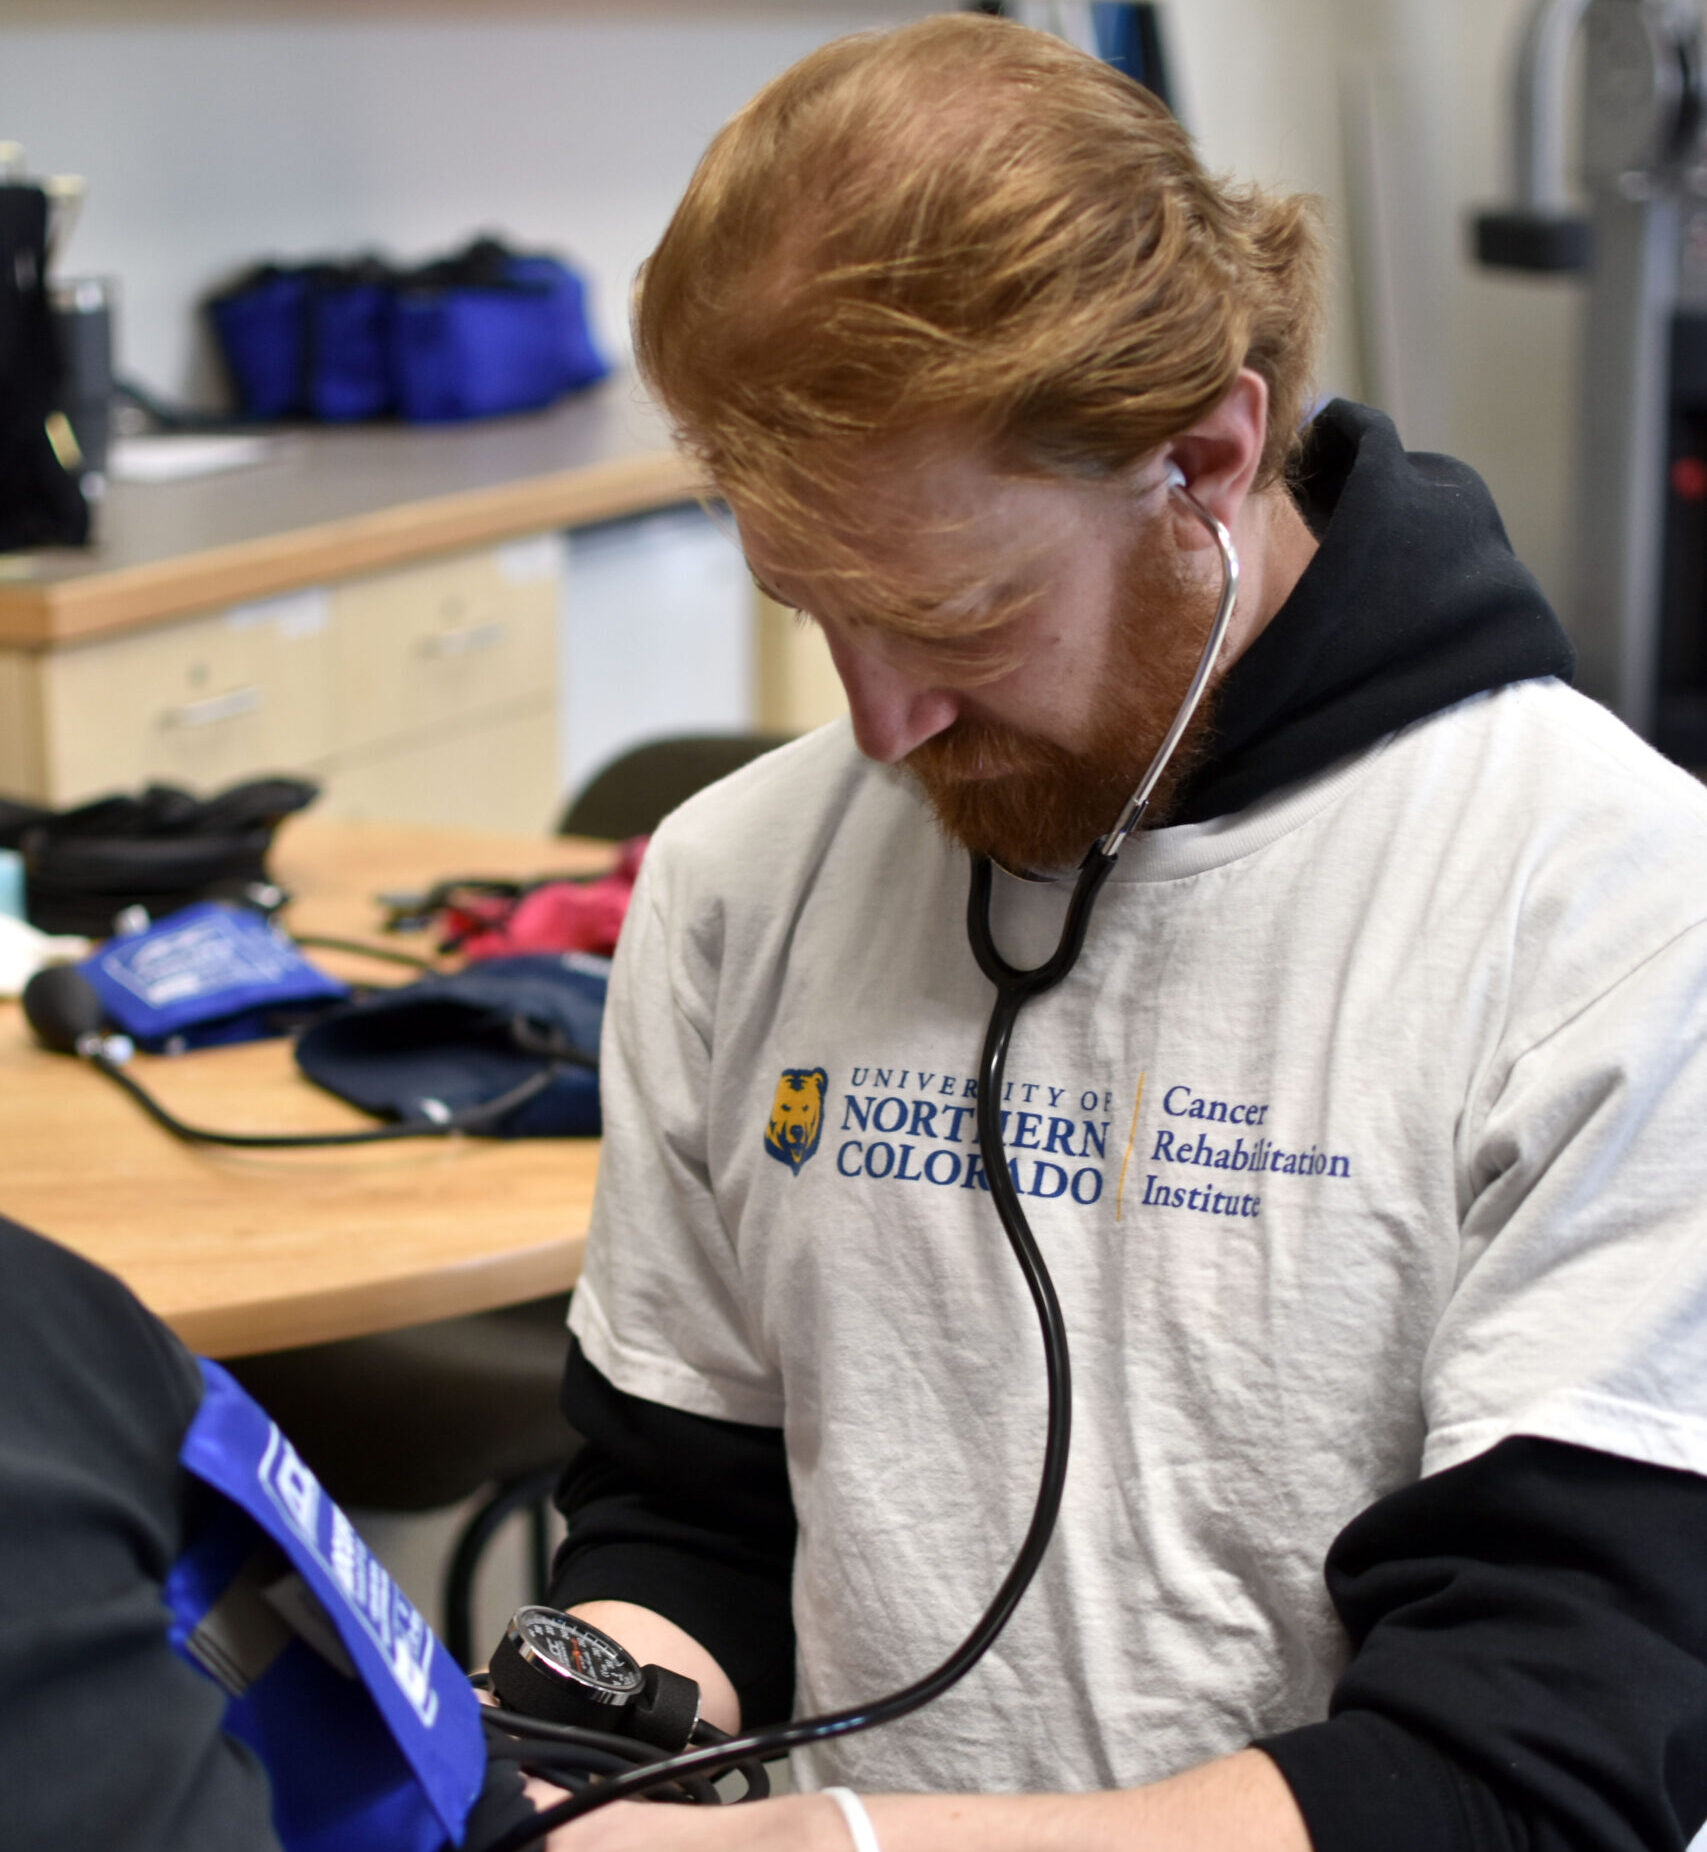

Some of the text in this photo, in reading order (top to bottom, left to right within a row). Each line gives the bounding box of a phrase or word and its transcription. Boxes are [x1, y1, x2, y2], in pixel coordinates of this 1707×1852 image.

[851, 1067, 1112, 1112] UNIVERITY OF
[1163, 1085, 1268, 1126] Cancer
[1151, 1130, 1351, 1178] Rehabilitation
[1141, 1174, 1262, 1218] Institute
